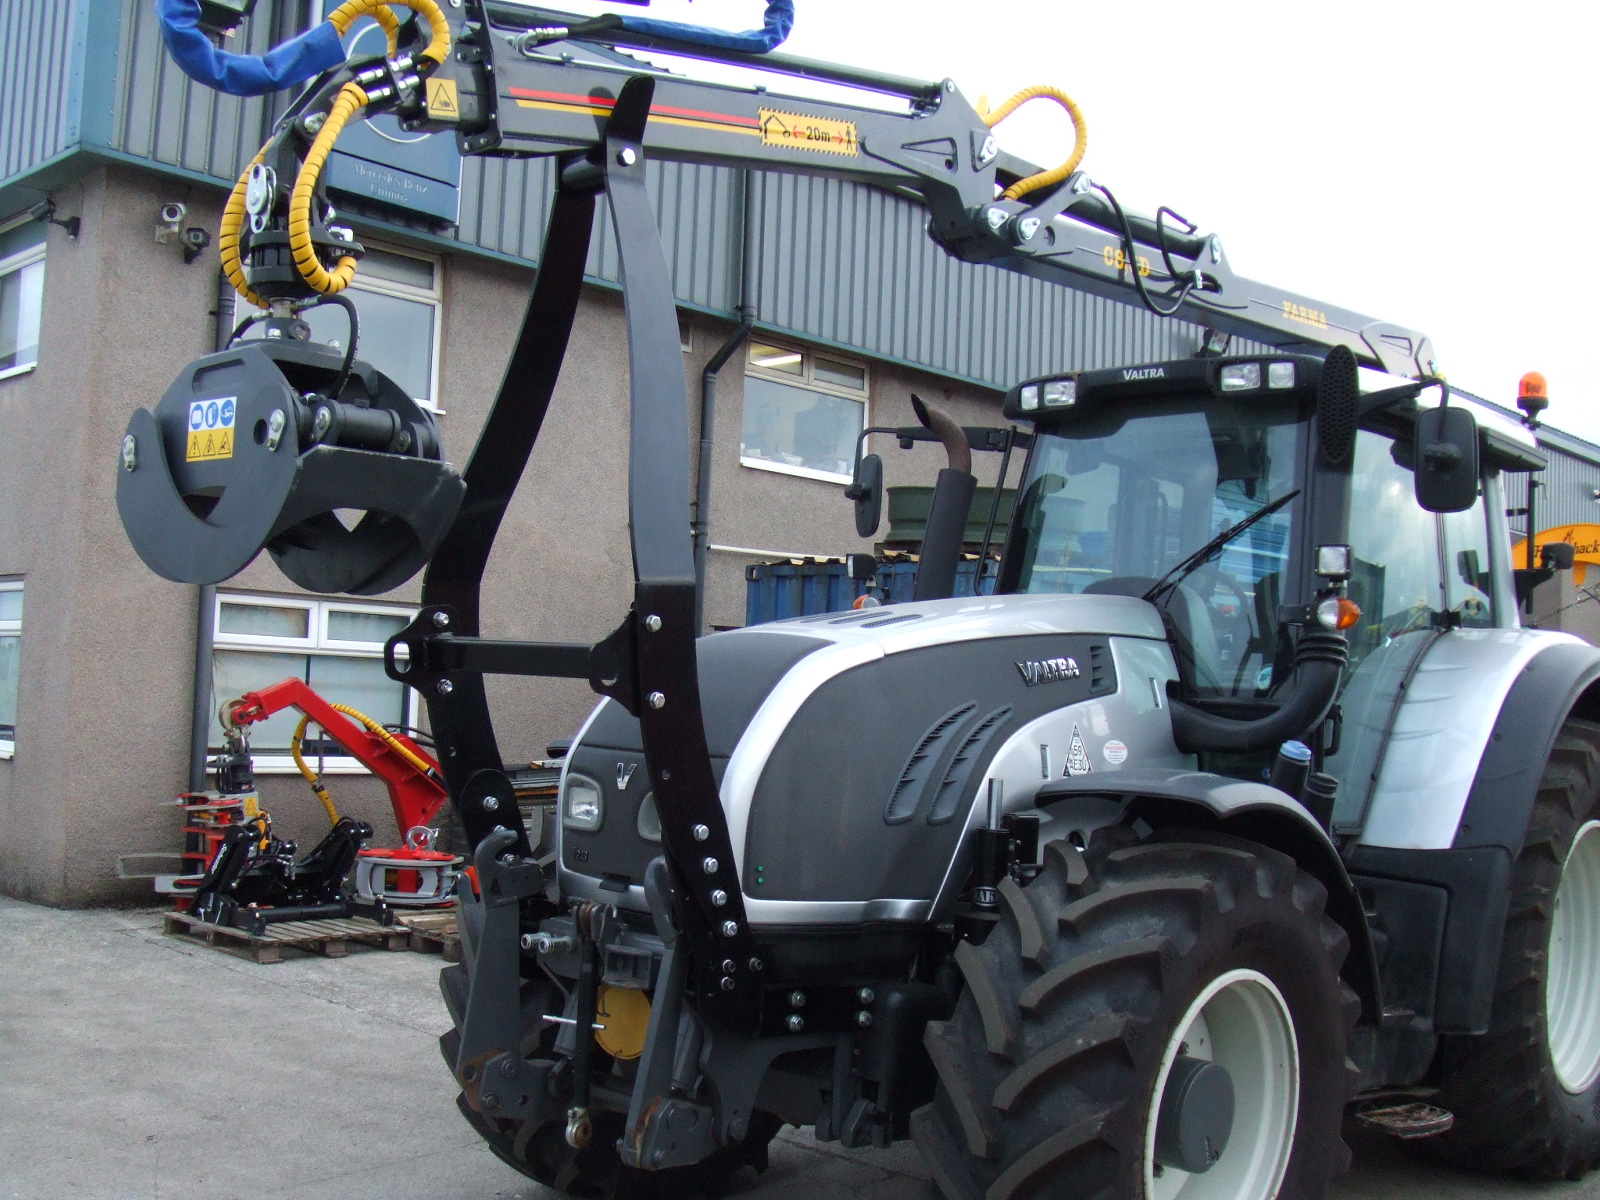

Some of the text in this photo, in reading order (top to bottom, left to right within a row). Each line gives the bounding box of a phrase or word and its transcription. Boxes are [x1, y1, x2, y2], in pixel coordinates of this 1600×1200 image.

[806, 125, 831, 143] 20m
[1282, 300, 1329, 330] FARMA
[1123, 367, 1165, 381] VALTRA
[1015, 656, 1080, 687] VALTRA
[1073, 744, 1083, 757] 59
